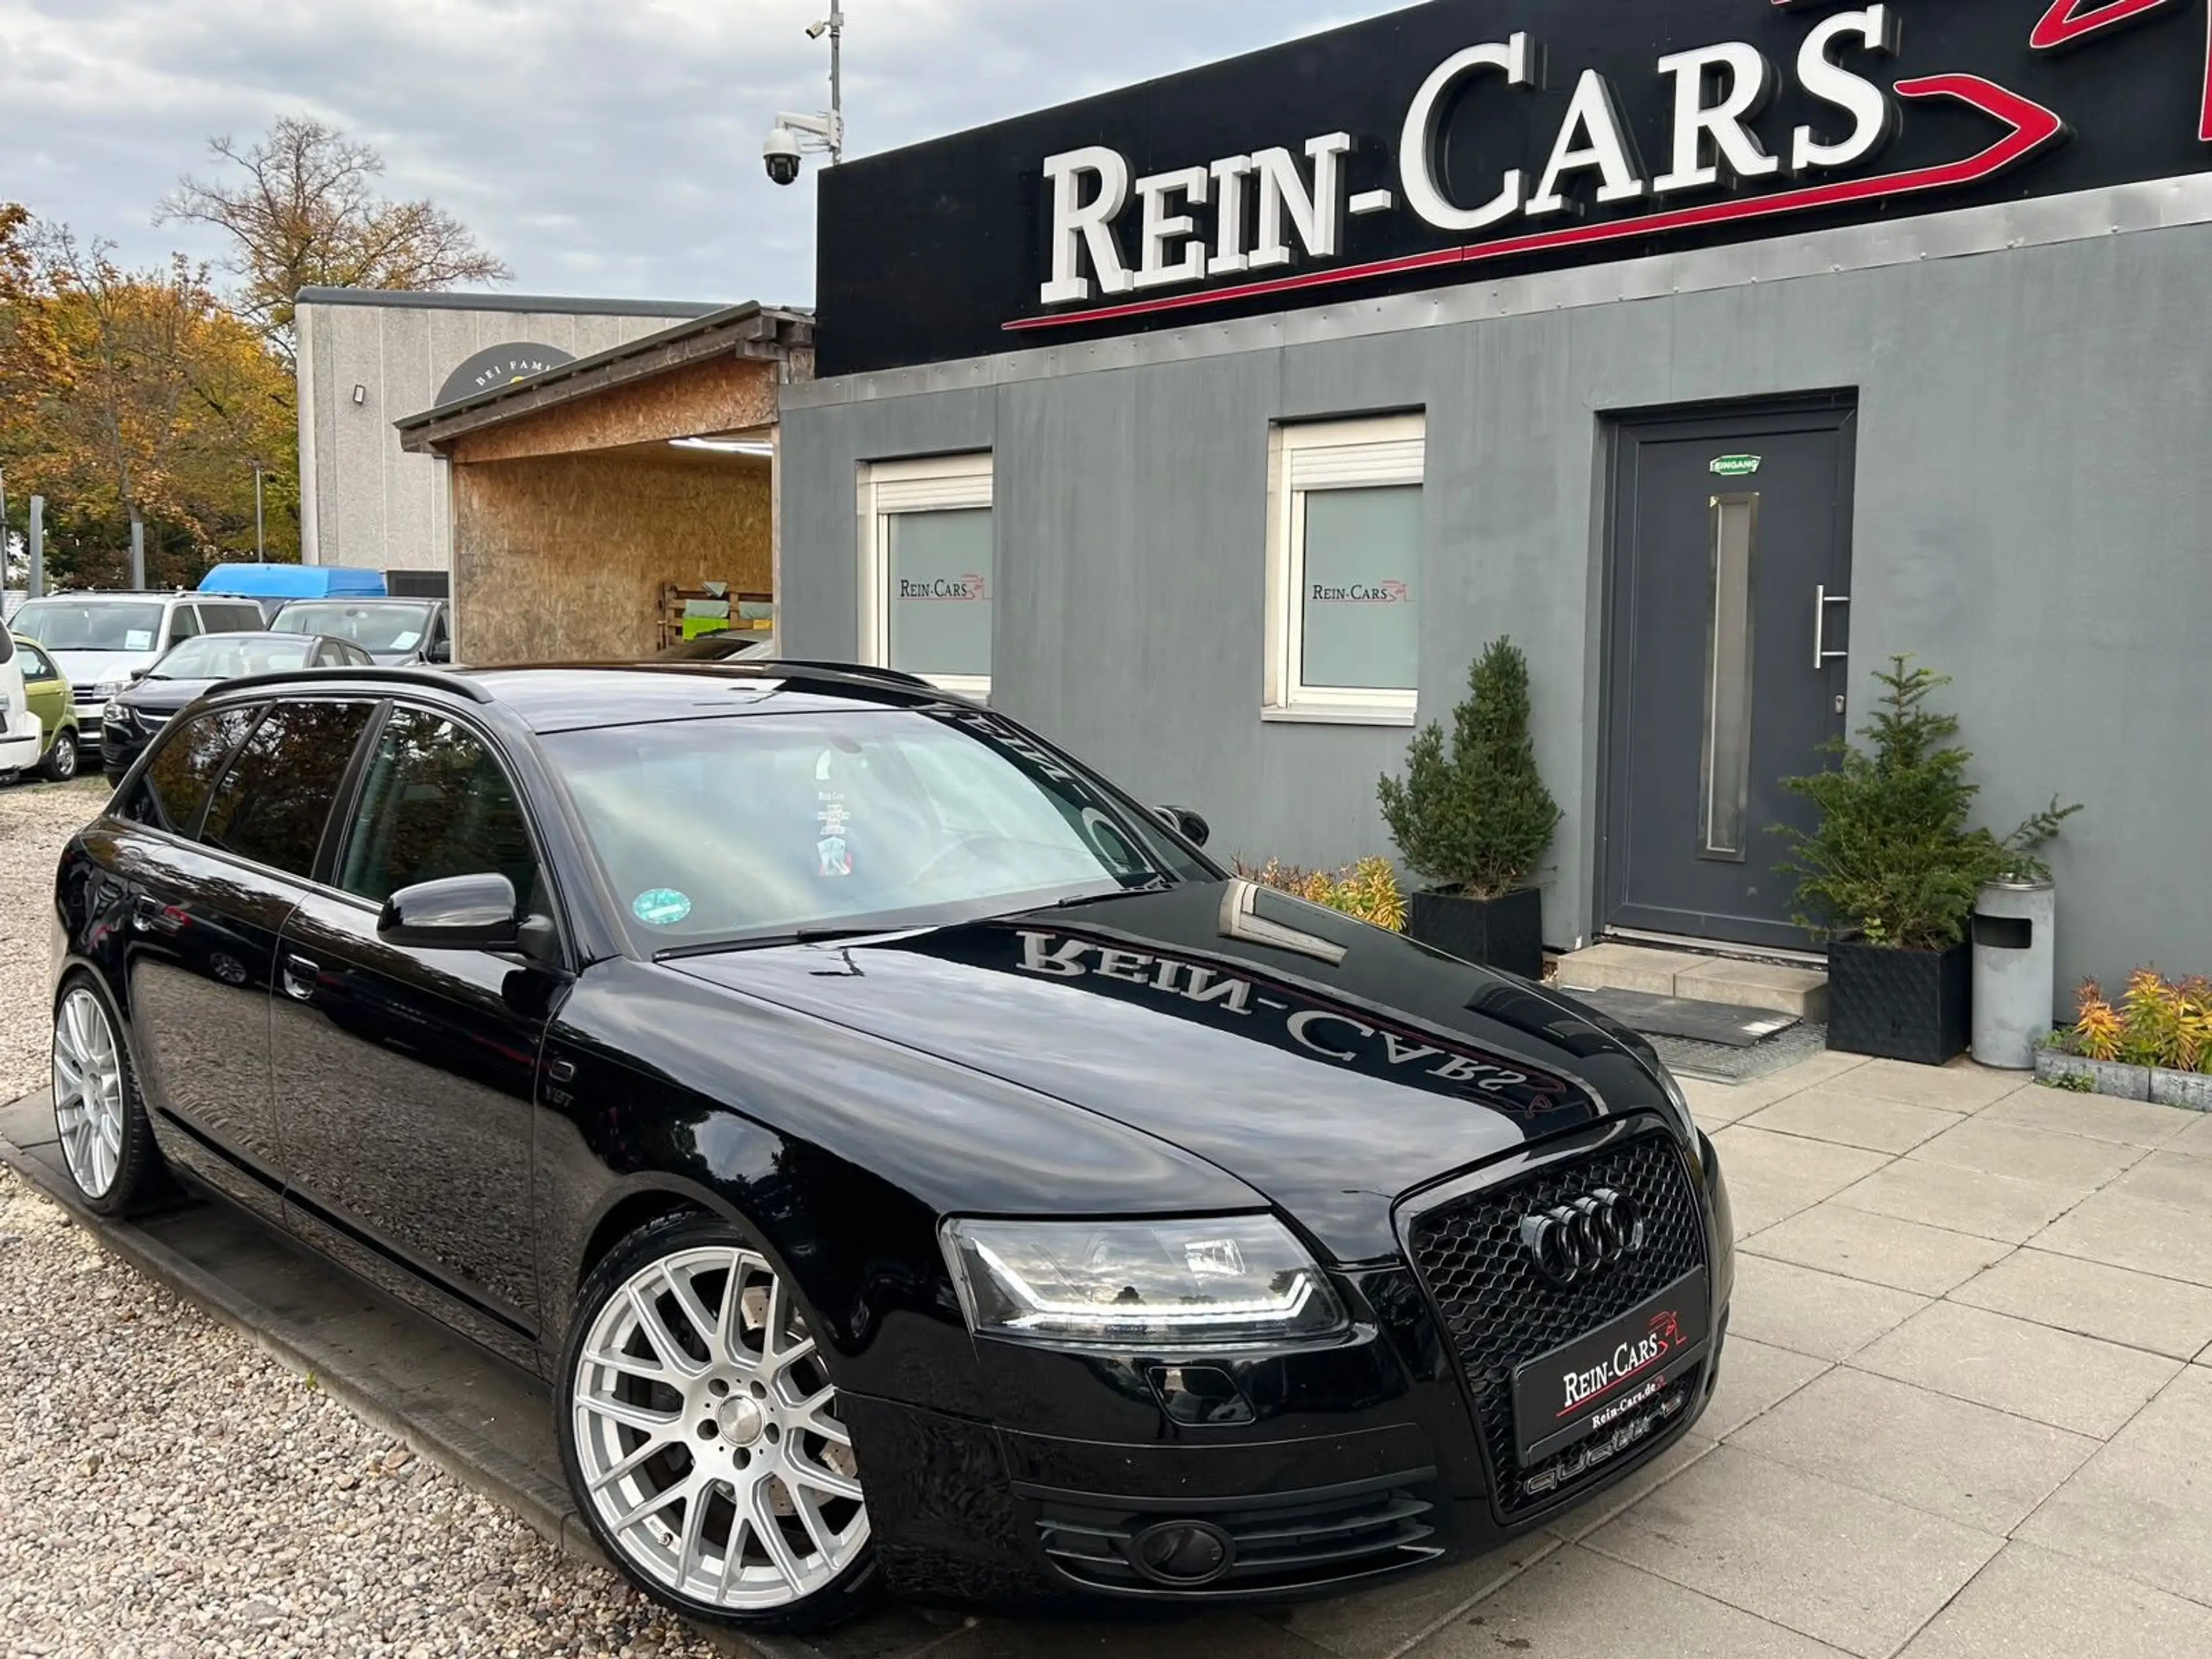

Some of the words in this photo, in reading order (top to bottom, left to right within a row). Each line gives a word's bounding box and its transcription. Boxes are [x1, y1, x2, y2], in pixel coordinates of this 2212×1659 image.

[1040, 3, 1889, 305] REIN-CARS
[475, 366, 501, 387] BEI
[900, 579, 967, 597] REIN-CARS
[1312, 584, 1388, 600] REIN-CARS
[1563, 1333, 1658, 1407] REIN-CARS
[1592, 1382, 1656, 1429] Rein-Cars.de
